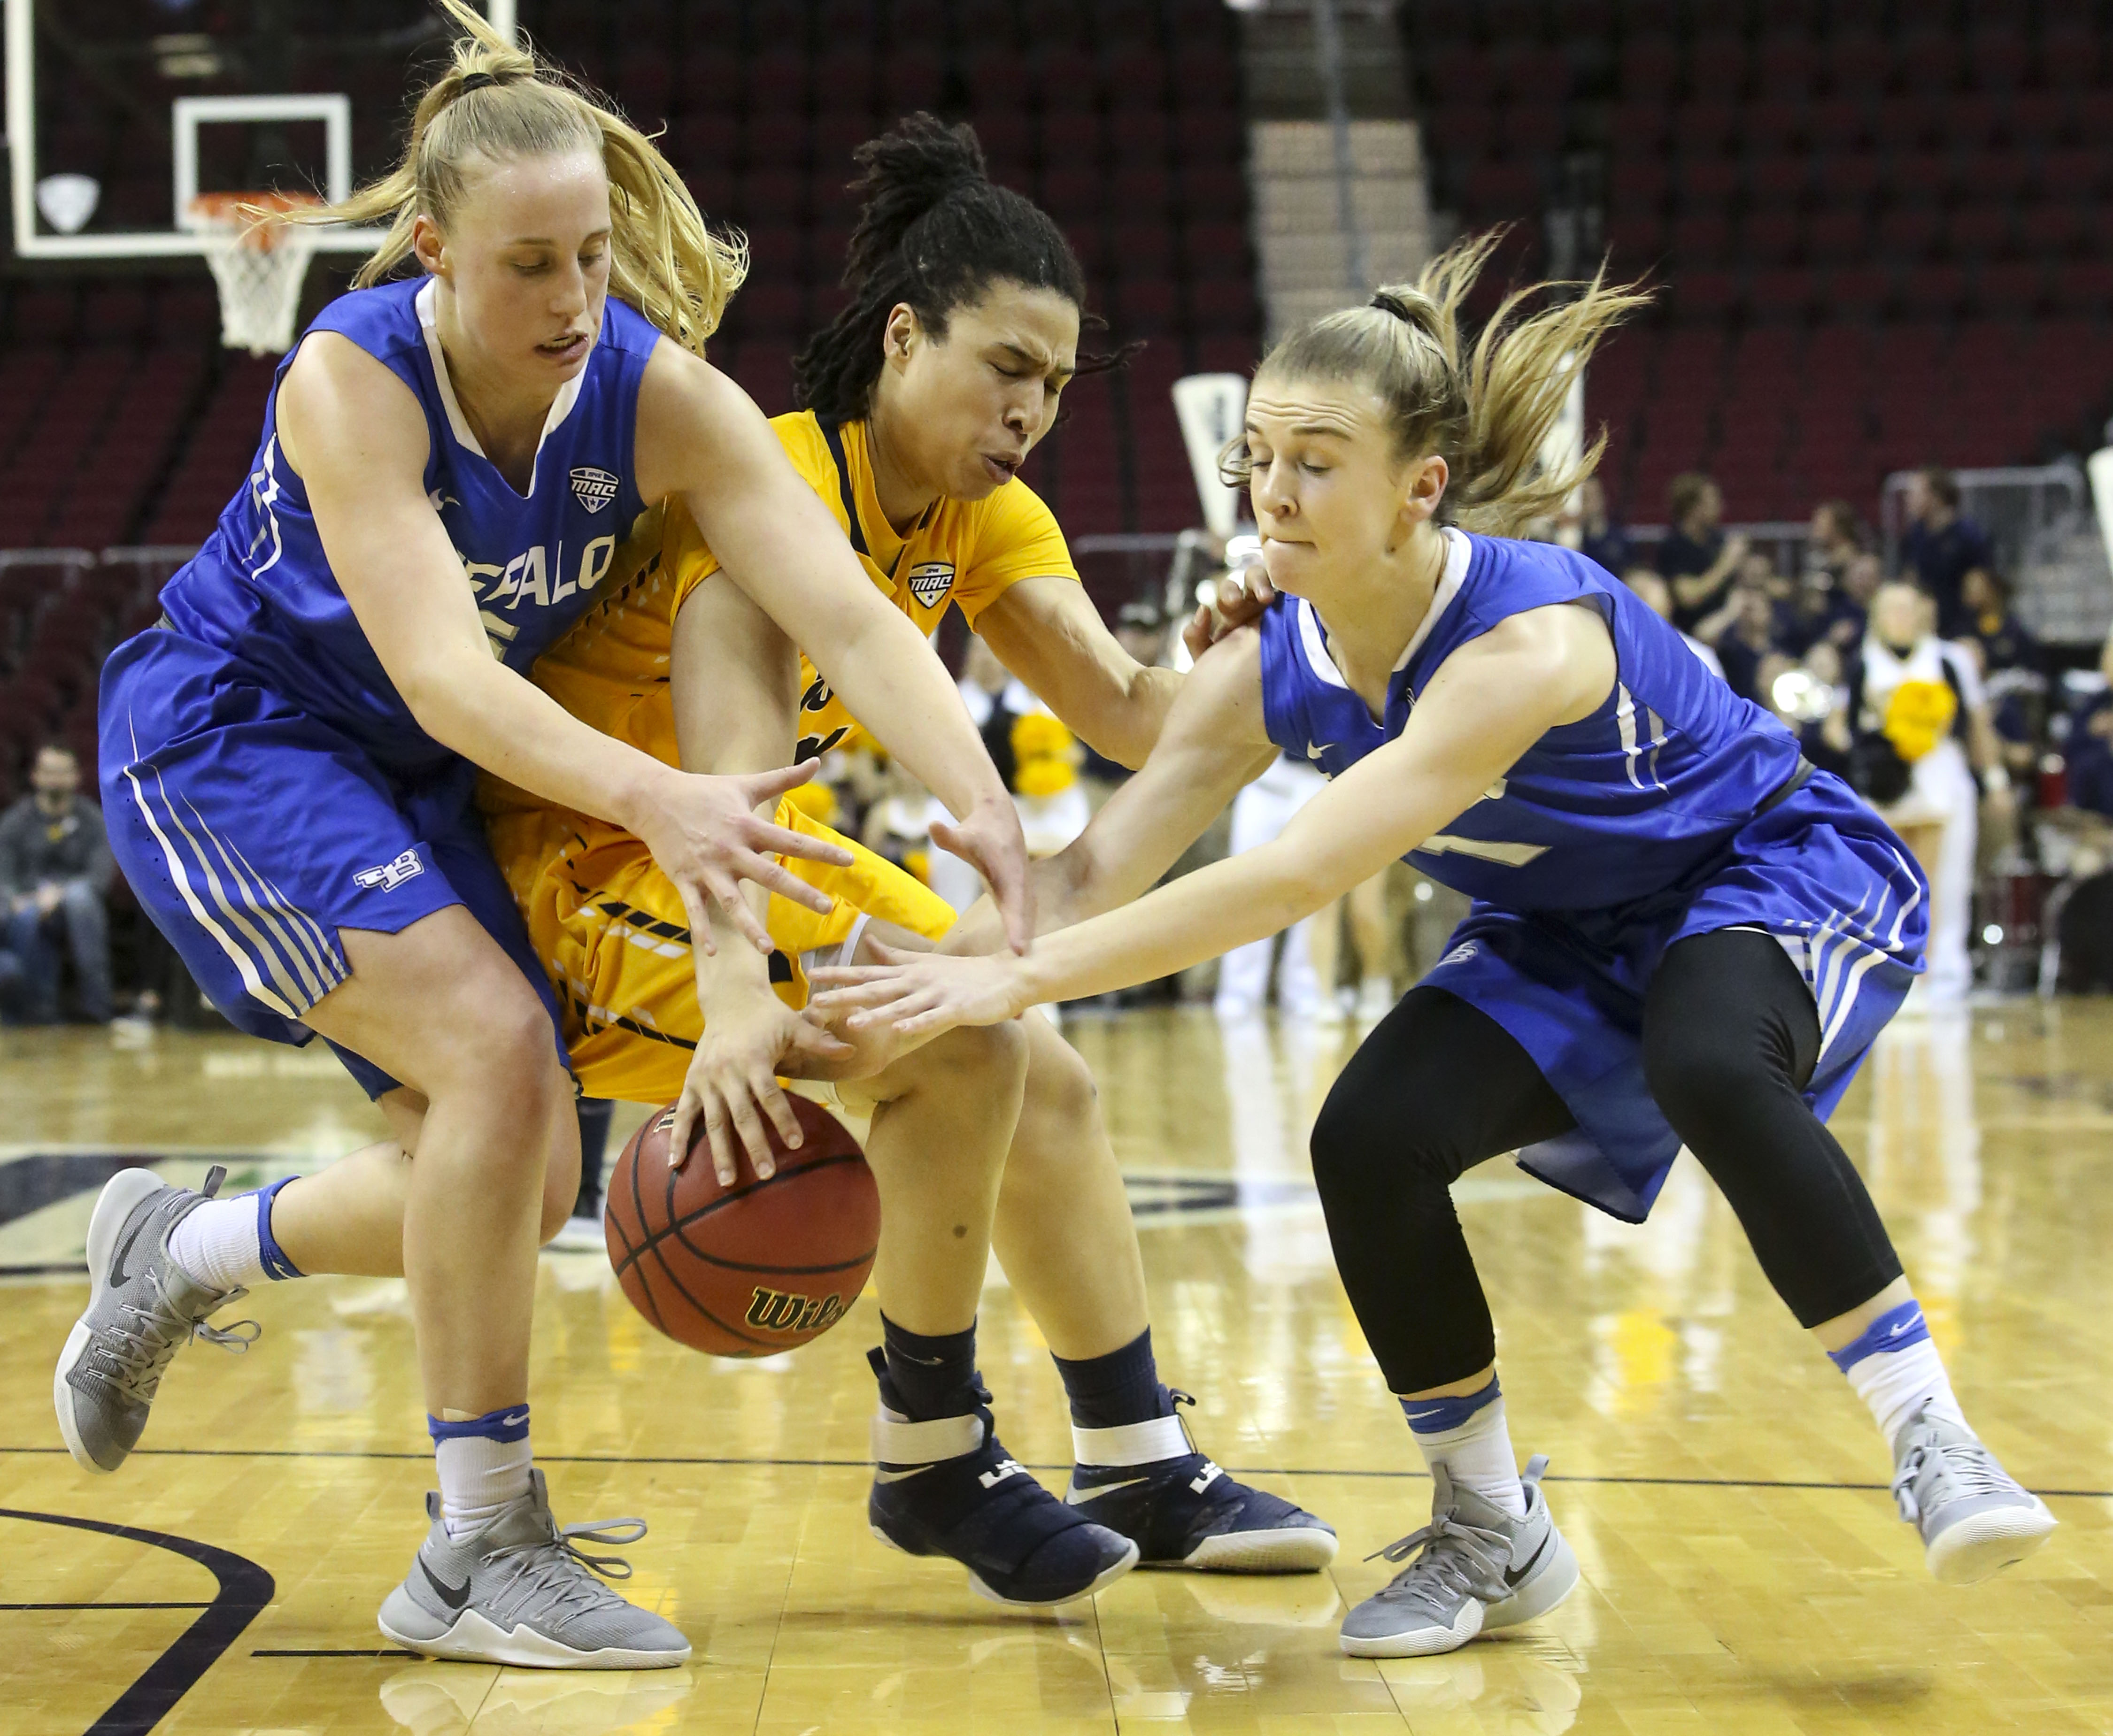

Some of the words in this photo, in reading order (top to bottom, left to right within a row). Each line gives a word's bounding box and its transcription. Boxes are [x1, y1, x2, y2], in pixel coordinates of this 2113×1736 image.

[572, 479, 617, 498] MAC
[456, 533, 615, 610] FFALO
[911, 576, 953, 591] MAC
